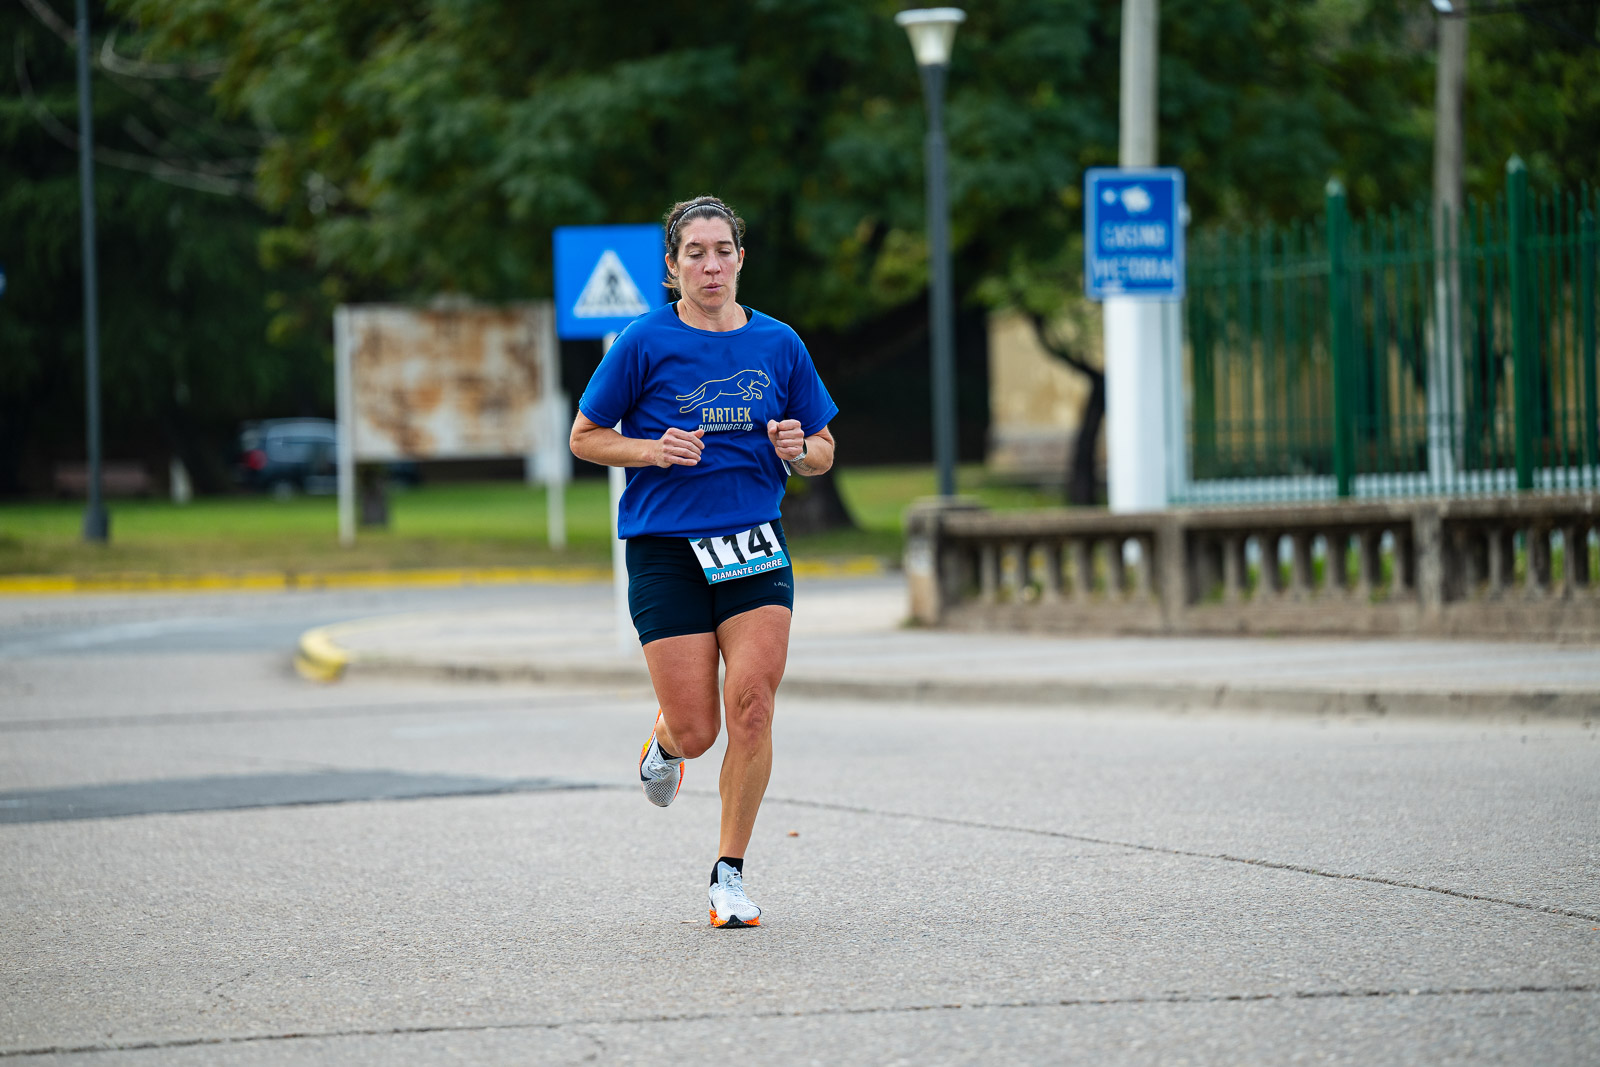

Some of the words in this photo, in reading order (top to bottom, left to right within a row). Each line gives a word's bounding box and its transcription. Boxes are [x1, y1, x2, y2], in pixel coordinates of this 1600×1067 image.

[702, 407, 752, 423] FARTLEK
[697, 525, 774, 569] 114
[711, 566, 753, 582] DIAMANTE
[754, 558, 783, 573] CORRE
